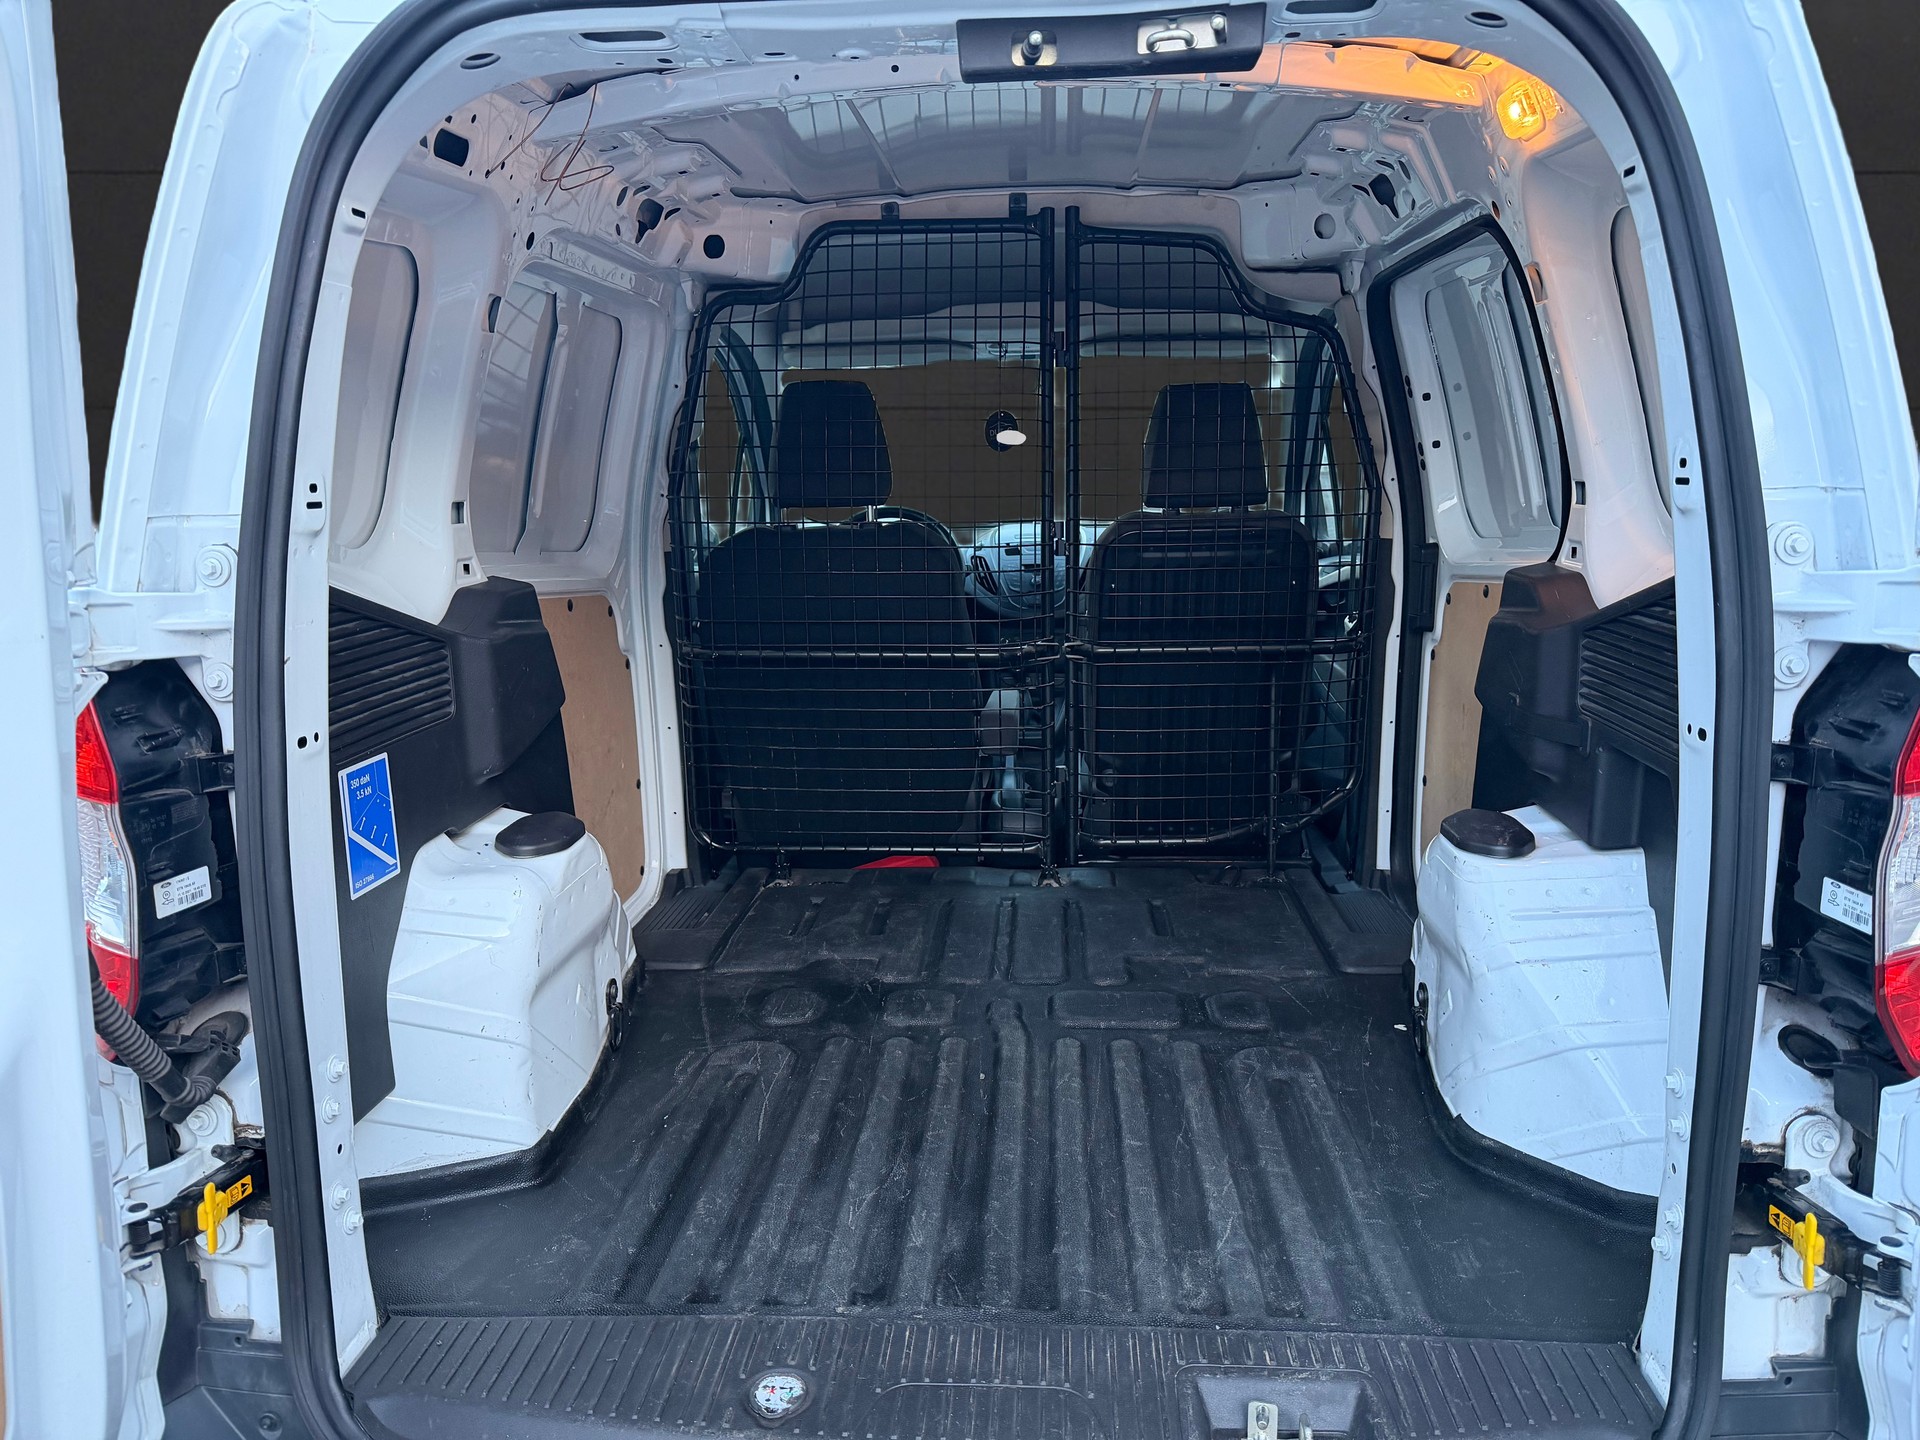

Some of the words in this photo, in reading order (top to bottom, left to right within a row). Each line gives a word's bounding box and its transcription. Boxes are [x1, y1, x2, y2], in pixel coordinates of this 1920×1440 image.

[350, 778, 360, 789] 350
[360, 773, 370, 785] daN
[356, 789, 365, 800] 3.5
[364, 785, 372, 796] kN
[355, 879, 363, 889] ISO
